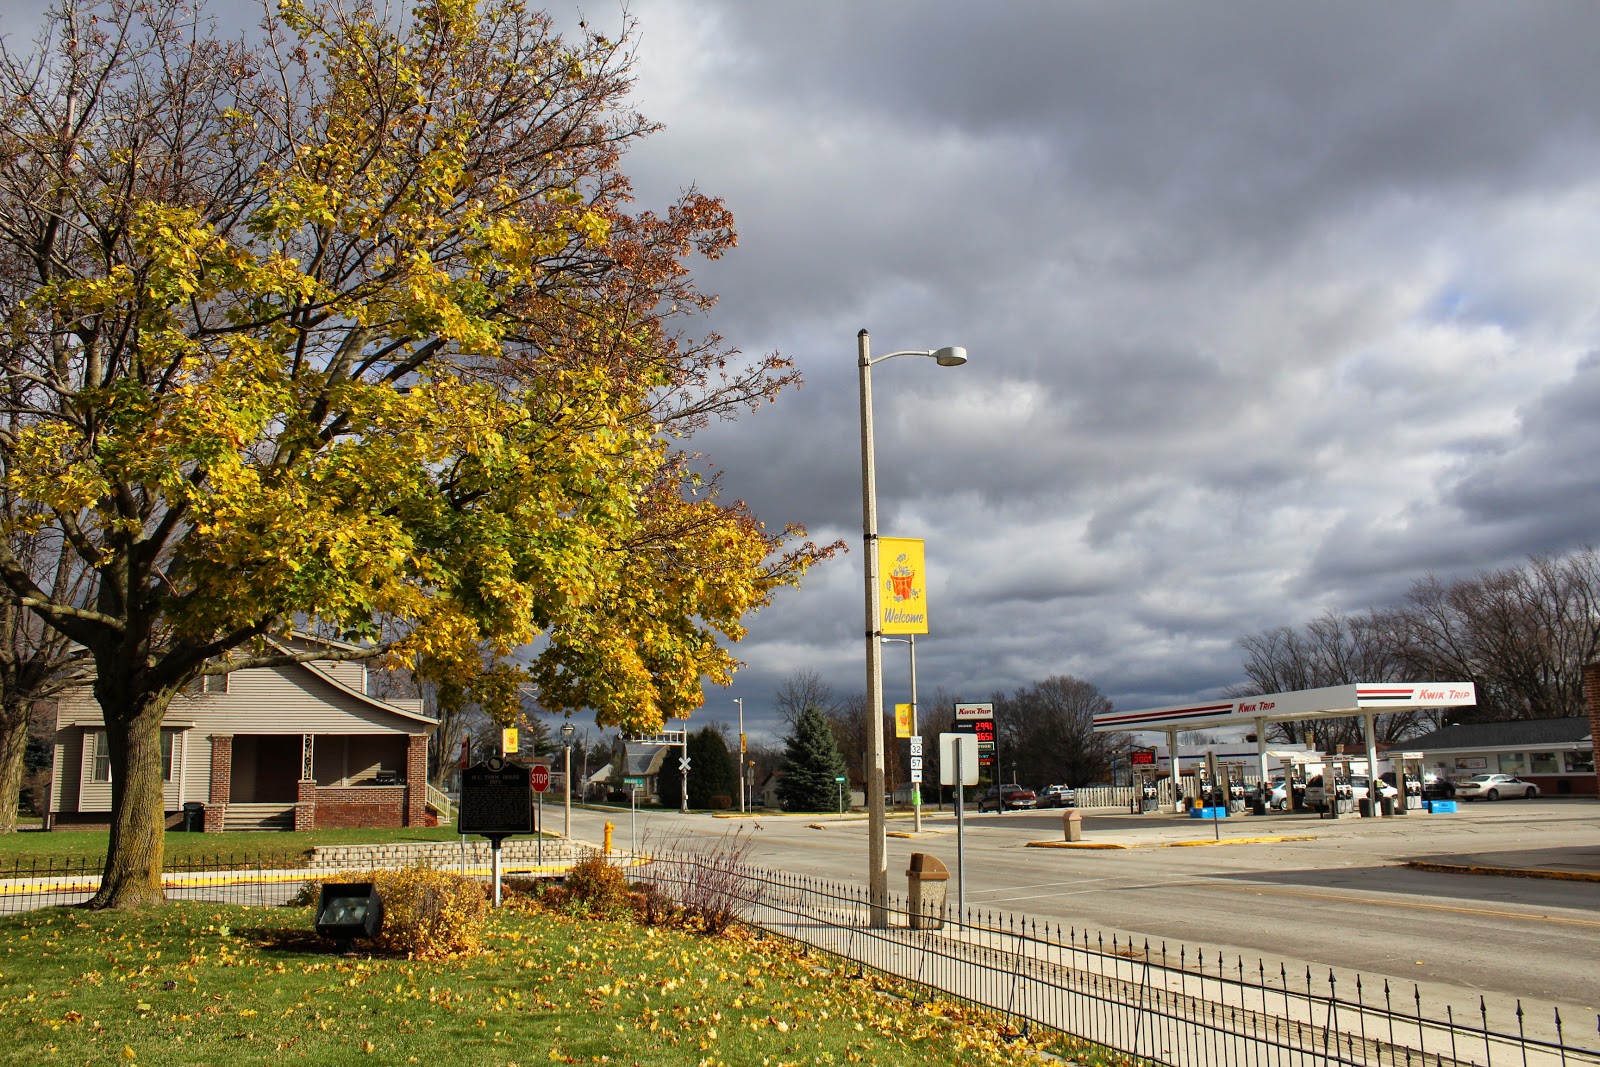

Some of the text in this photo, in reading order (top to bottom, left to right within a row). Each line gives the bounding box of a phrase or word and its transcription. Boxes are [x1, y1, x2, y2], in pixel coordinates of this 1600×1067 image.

[884, 608, 924, 623] Welcome
[912, 745, 920, 754] 32
[912, 759, 920, 767] 57
[531, 773, 548, 784] STOP
